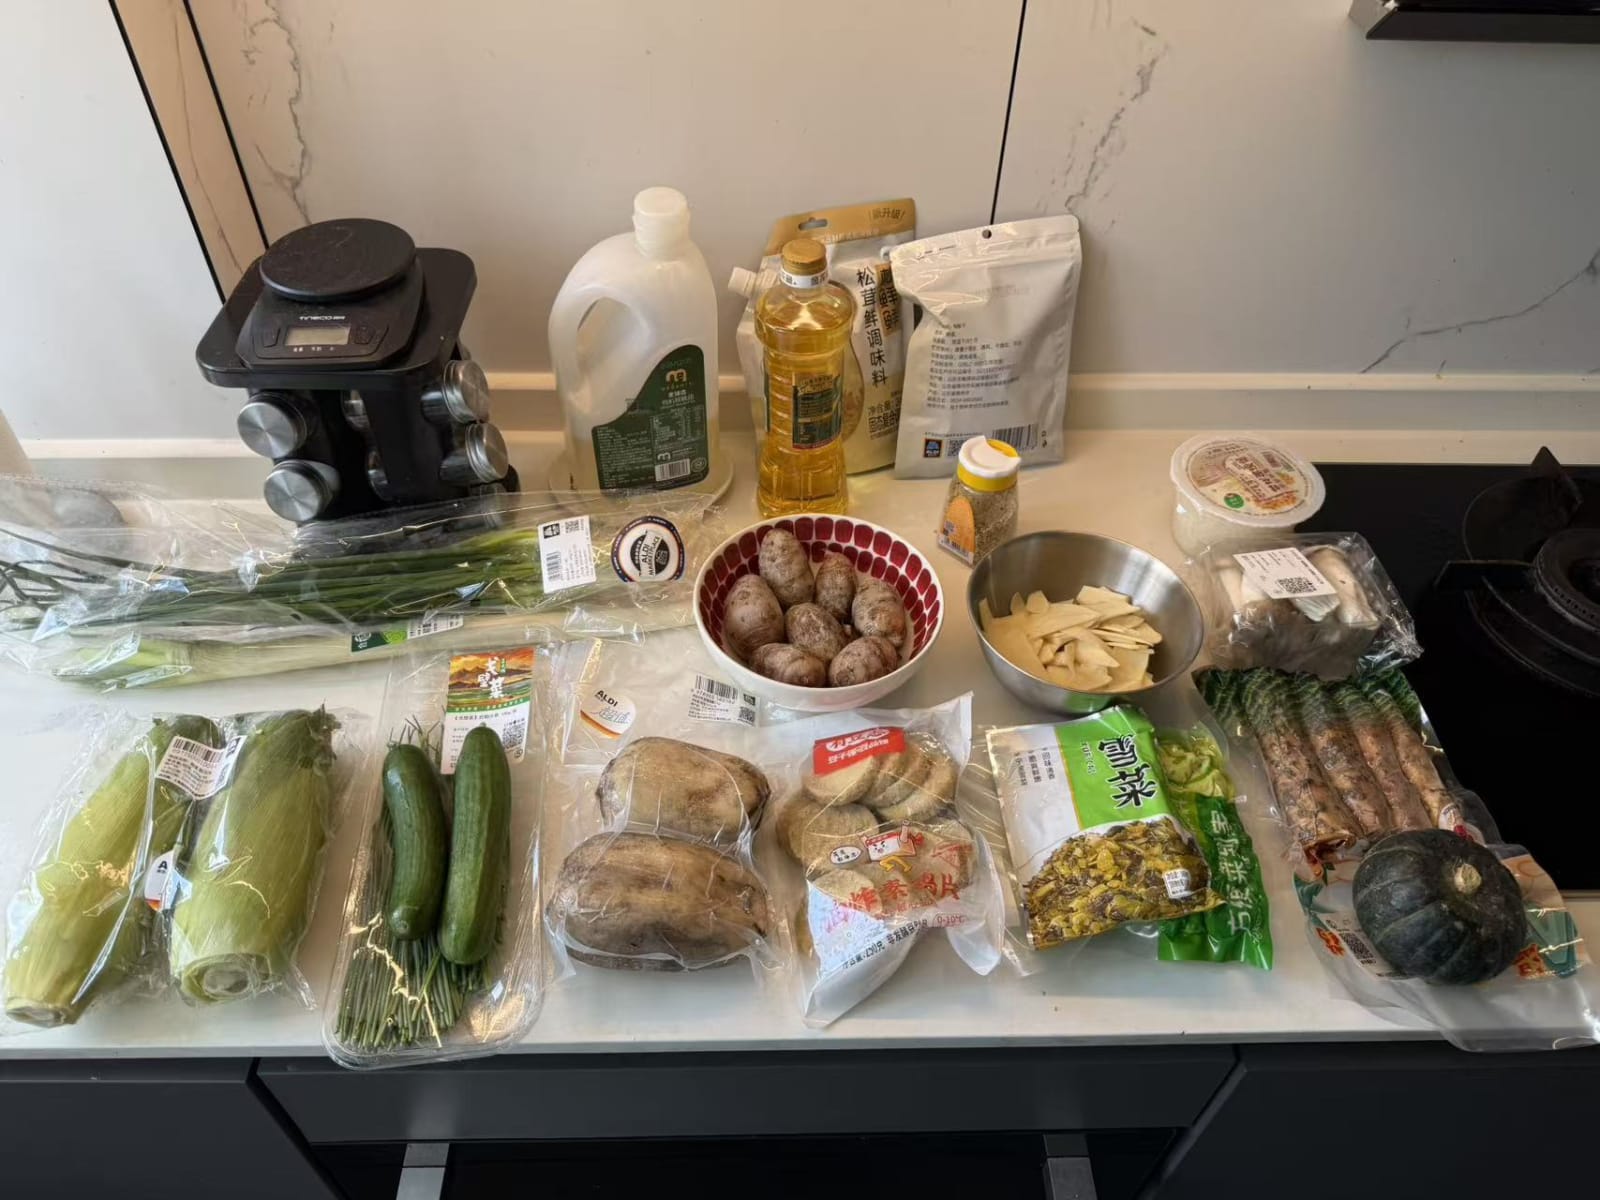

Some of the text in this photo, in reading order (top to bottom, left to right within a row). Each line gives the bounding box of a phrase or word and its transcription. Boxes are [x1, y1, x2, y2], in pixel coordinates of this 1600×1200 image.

[856, 265, 888, 388] 松茸鲜调味料
[596, 689, 618, 708] ALDI
[1098, 734, 1157, 808] 雪菜
